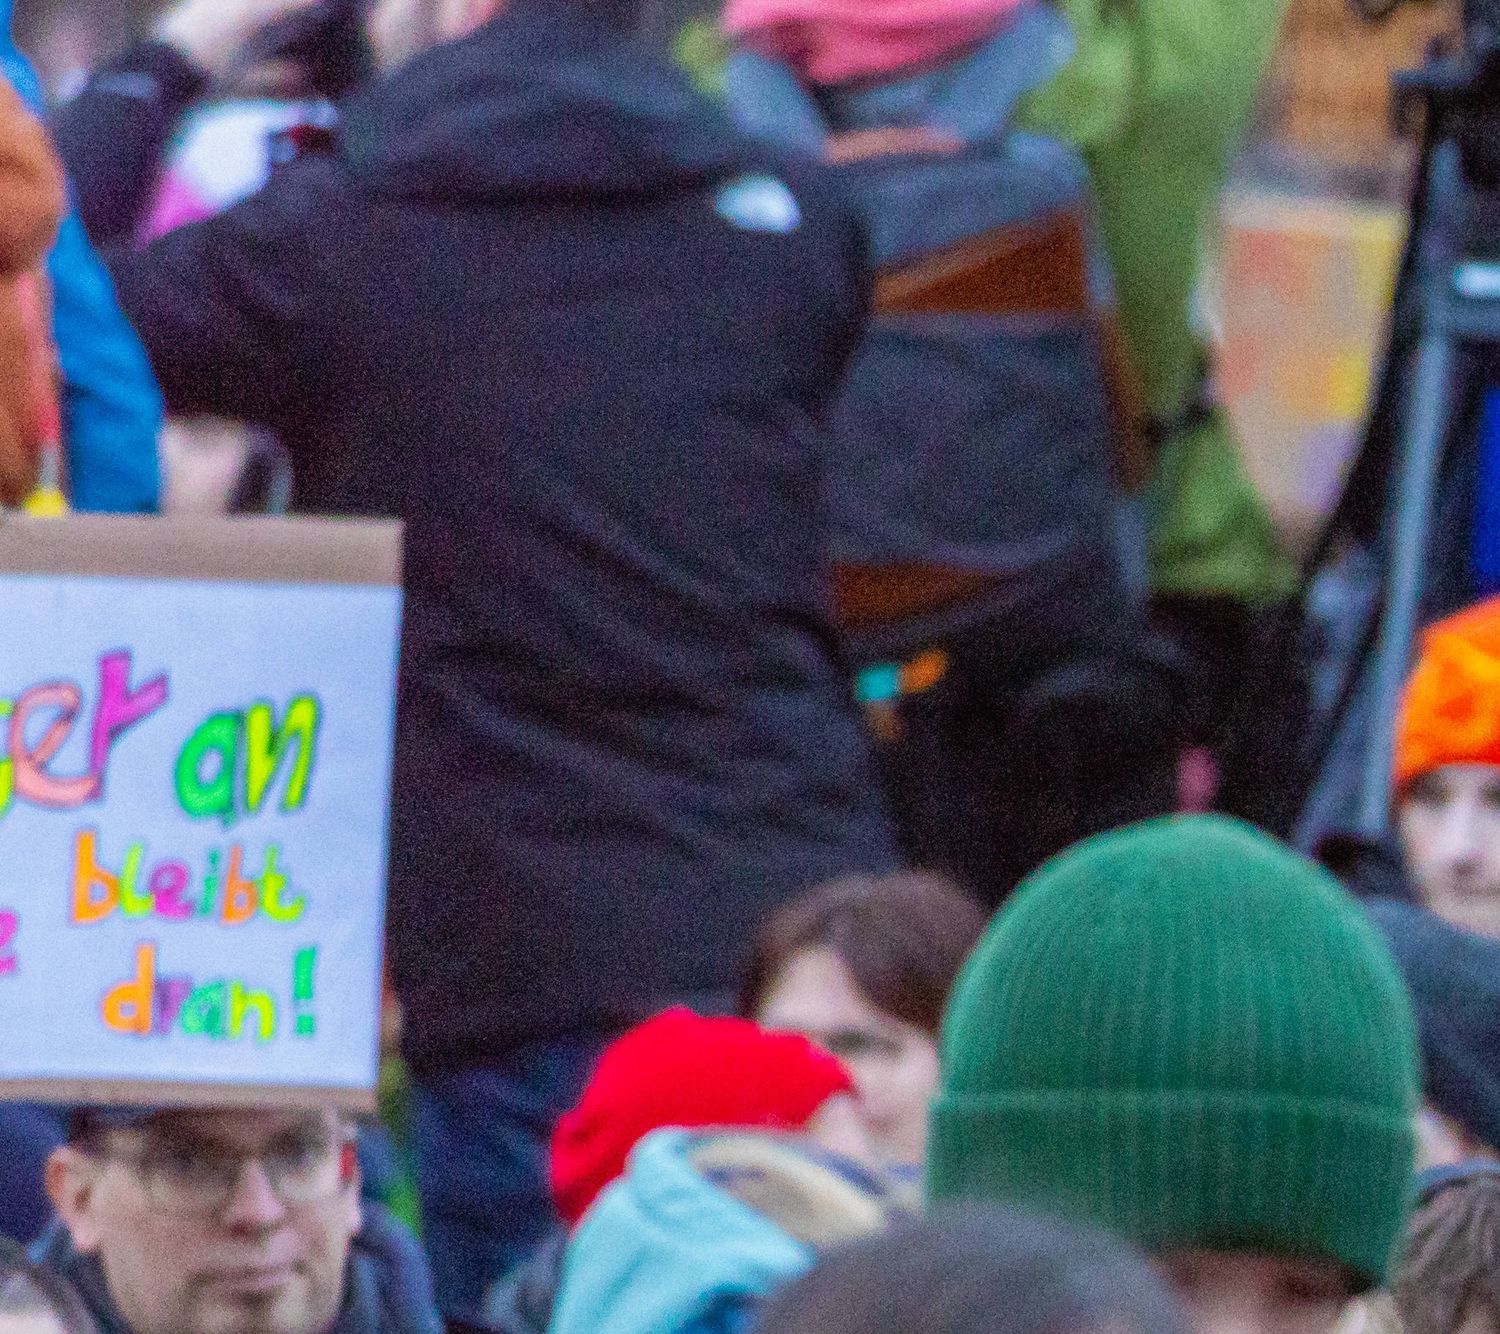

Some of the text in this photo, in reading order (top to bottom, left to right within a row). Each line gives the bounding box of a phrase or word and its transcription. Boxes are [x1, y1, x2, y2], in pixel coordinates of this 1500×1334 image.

[174, 692, 320, 830] an
[72, 826, 305, 924] bleibt
[103, 942, 318, 1042] dran!
